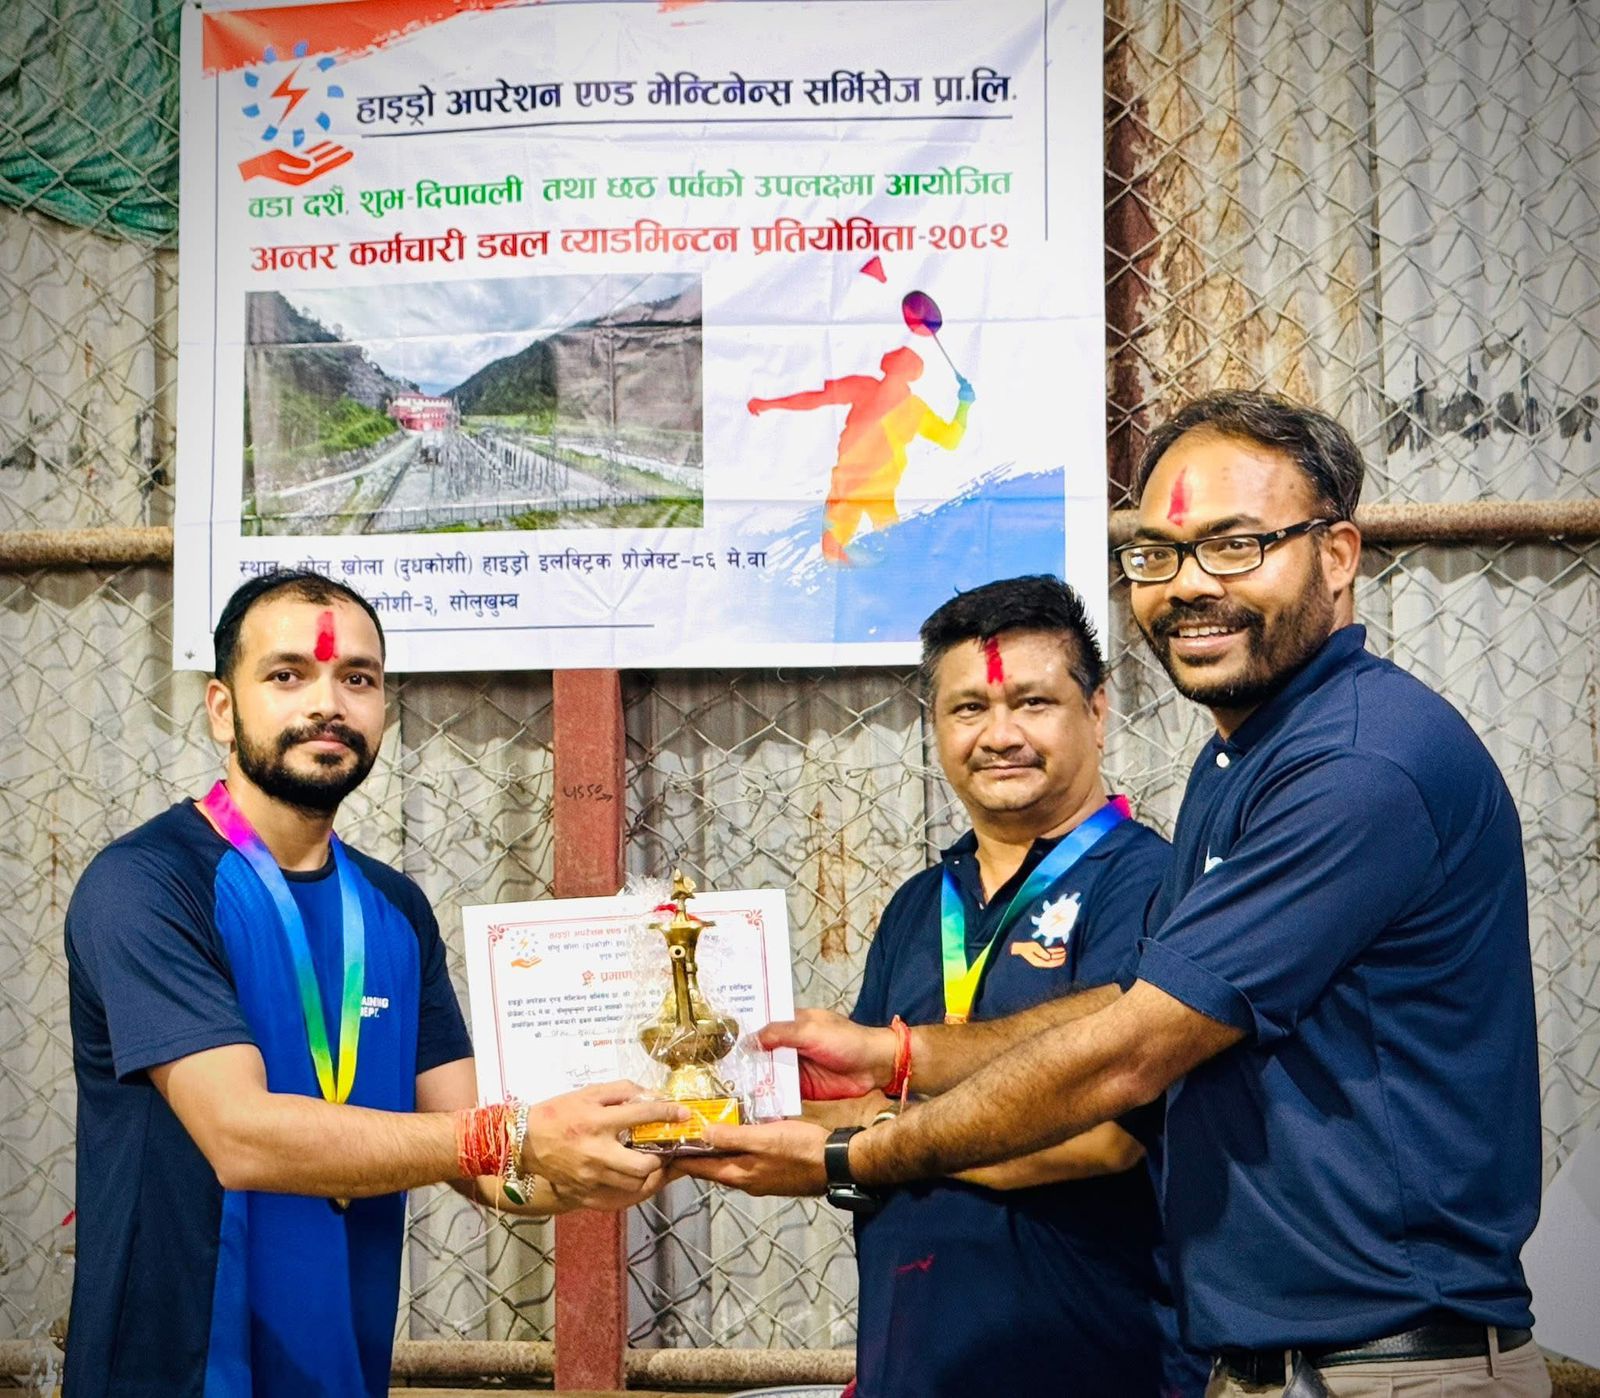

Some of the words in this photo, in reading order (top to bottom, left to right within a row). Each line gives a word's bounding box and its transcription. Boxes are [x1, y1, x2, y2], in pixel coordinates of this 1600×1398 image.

[357, 84, 436, 126] हाइड्रो
[446, 78, 563, 116] अपरेशन
[574, 79, 637, 106] एण्ड
[647, 71, 793, 107] मेन्टिनेन्स
[542, 177, 597, 201] तथा
[606, 177, 658, 199] छठ
[668, 169, 745, 198] पर्वको
[884, 166, 1013, 197] आयोजित
[250, 242, 339, 272] अन्तर
[349, 228, 466, 266] कर्मचारी
[477, 229, 550, 258] डबल
[341, 554, 384, 576] खोला
[482, 550, 530, 577] हाइड्रो
[366, 589, 438, 617] कोशी-३,
